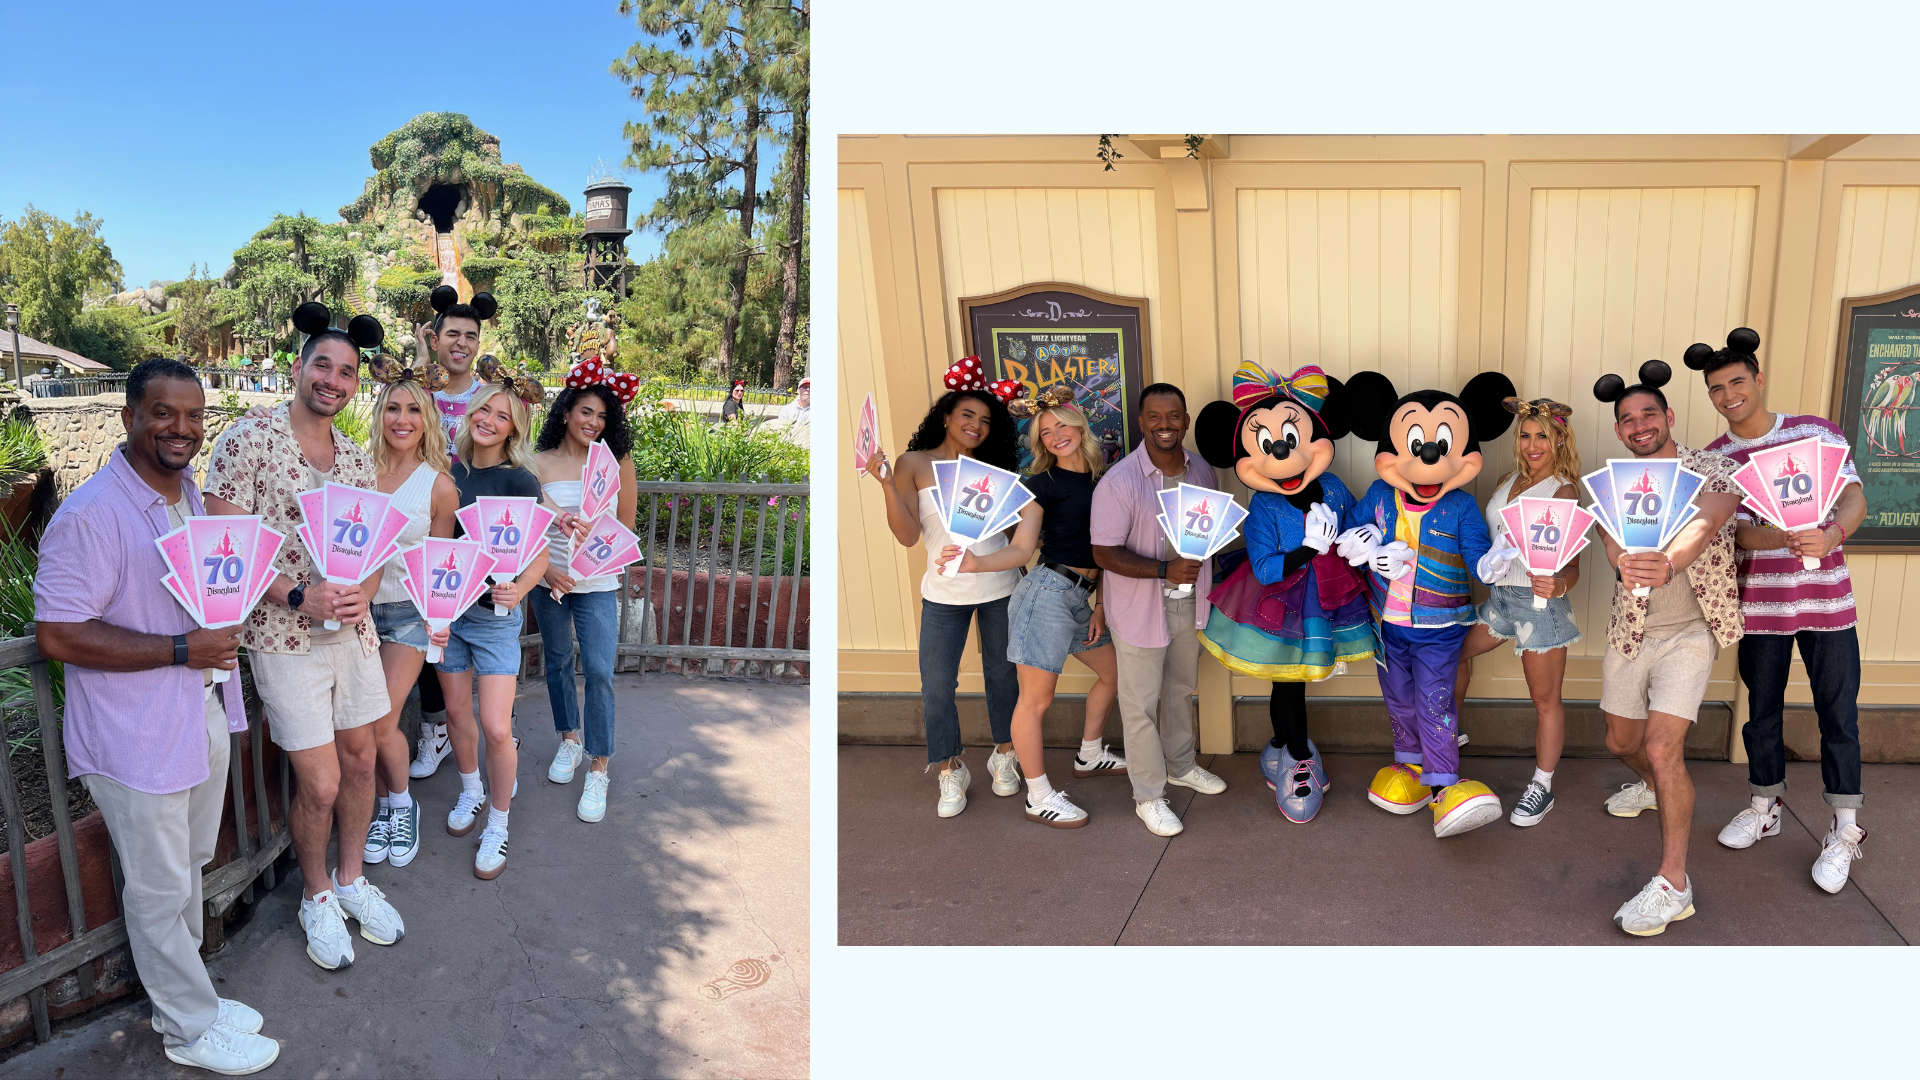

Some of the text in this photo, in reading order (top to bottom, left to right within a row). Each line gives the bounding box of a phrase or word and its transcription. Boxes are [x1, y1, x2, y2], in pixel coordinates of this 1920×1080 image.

[1869, 344, 1912, 358] ENCHANTED
[1003, 356, 1117, 400] BLASTERS
[592, 470, 606, 496] 70
[1773, 473, 1813, 499] 70
[959, 486, 994, 513] 70
[1624, 492, 1663, 516] 70
[1781, 494, 1813, 508] Disneyland
[957, 507, 986, 521] Disneyland
[1185, 510, 1214, 533] 70
[1626, 516, 1658, 526] Disneyland
[332, 518, 370, 547] 70
[489, 525, 521, 546] 70
[1530, 524, 1561, 545] 70
[331, 543, 362, 557] Disneyland
[491, 546, 517, 554] Disneyland
[587, 535, 612, 560] 70
[1531, 544, 1557, 552] Disneyland
[204, 555, 244, 584] 70
[431, 568, 462, 591] 70
[206, 585, 240, 596] Disneyland
[430, 590, 457, 599] Disneyland
